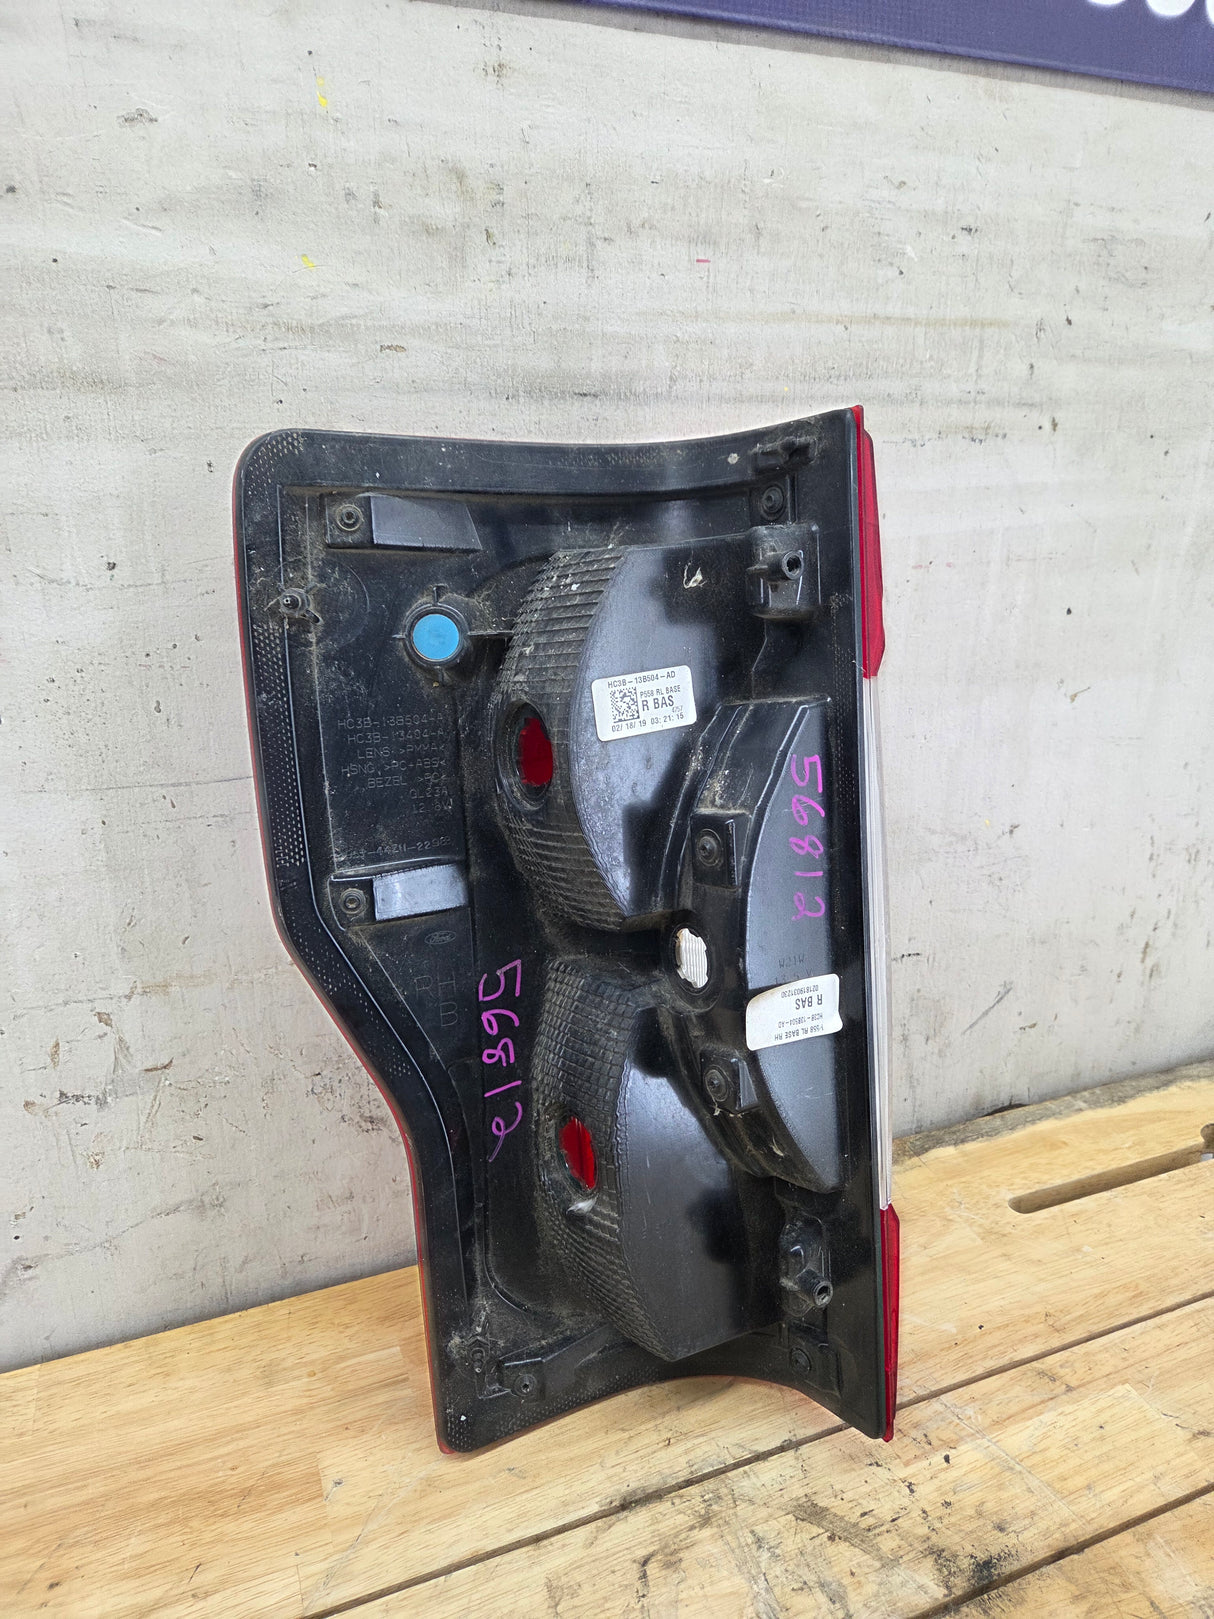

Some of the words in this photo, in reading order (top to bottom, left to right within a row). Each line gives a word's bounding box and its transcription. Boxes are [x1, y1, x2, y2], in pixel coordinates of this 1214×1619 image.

[665, 684, 681, 695] BASE
[641, 699, 650, 712] R
[653, 694, 675, 710] BAS
[789, 754, 826, 922] 56812
[795, 995, 813, 1010] BAS
[816, 993, 823, 1005] R
[784, 1029, 800, 1039] BASE
[478, 959, 523, 1162] 56812
